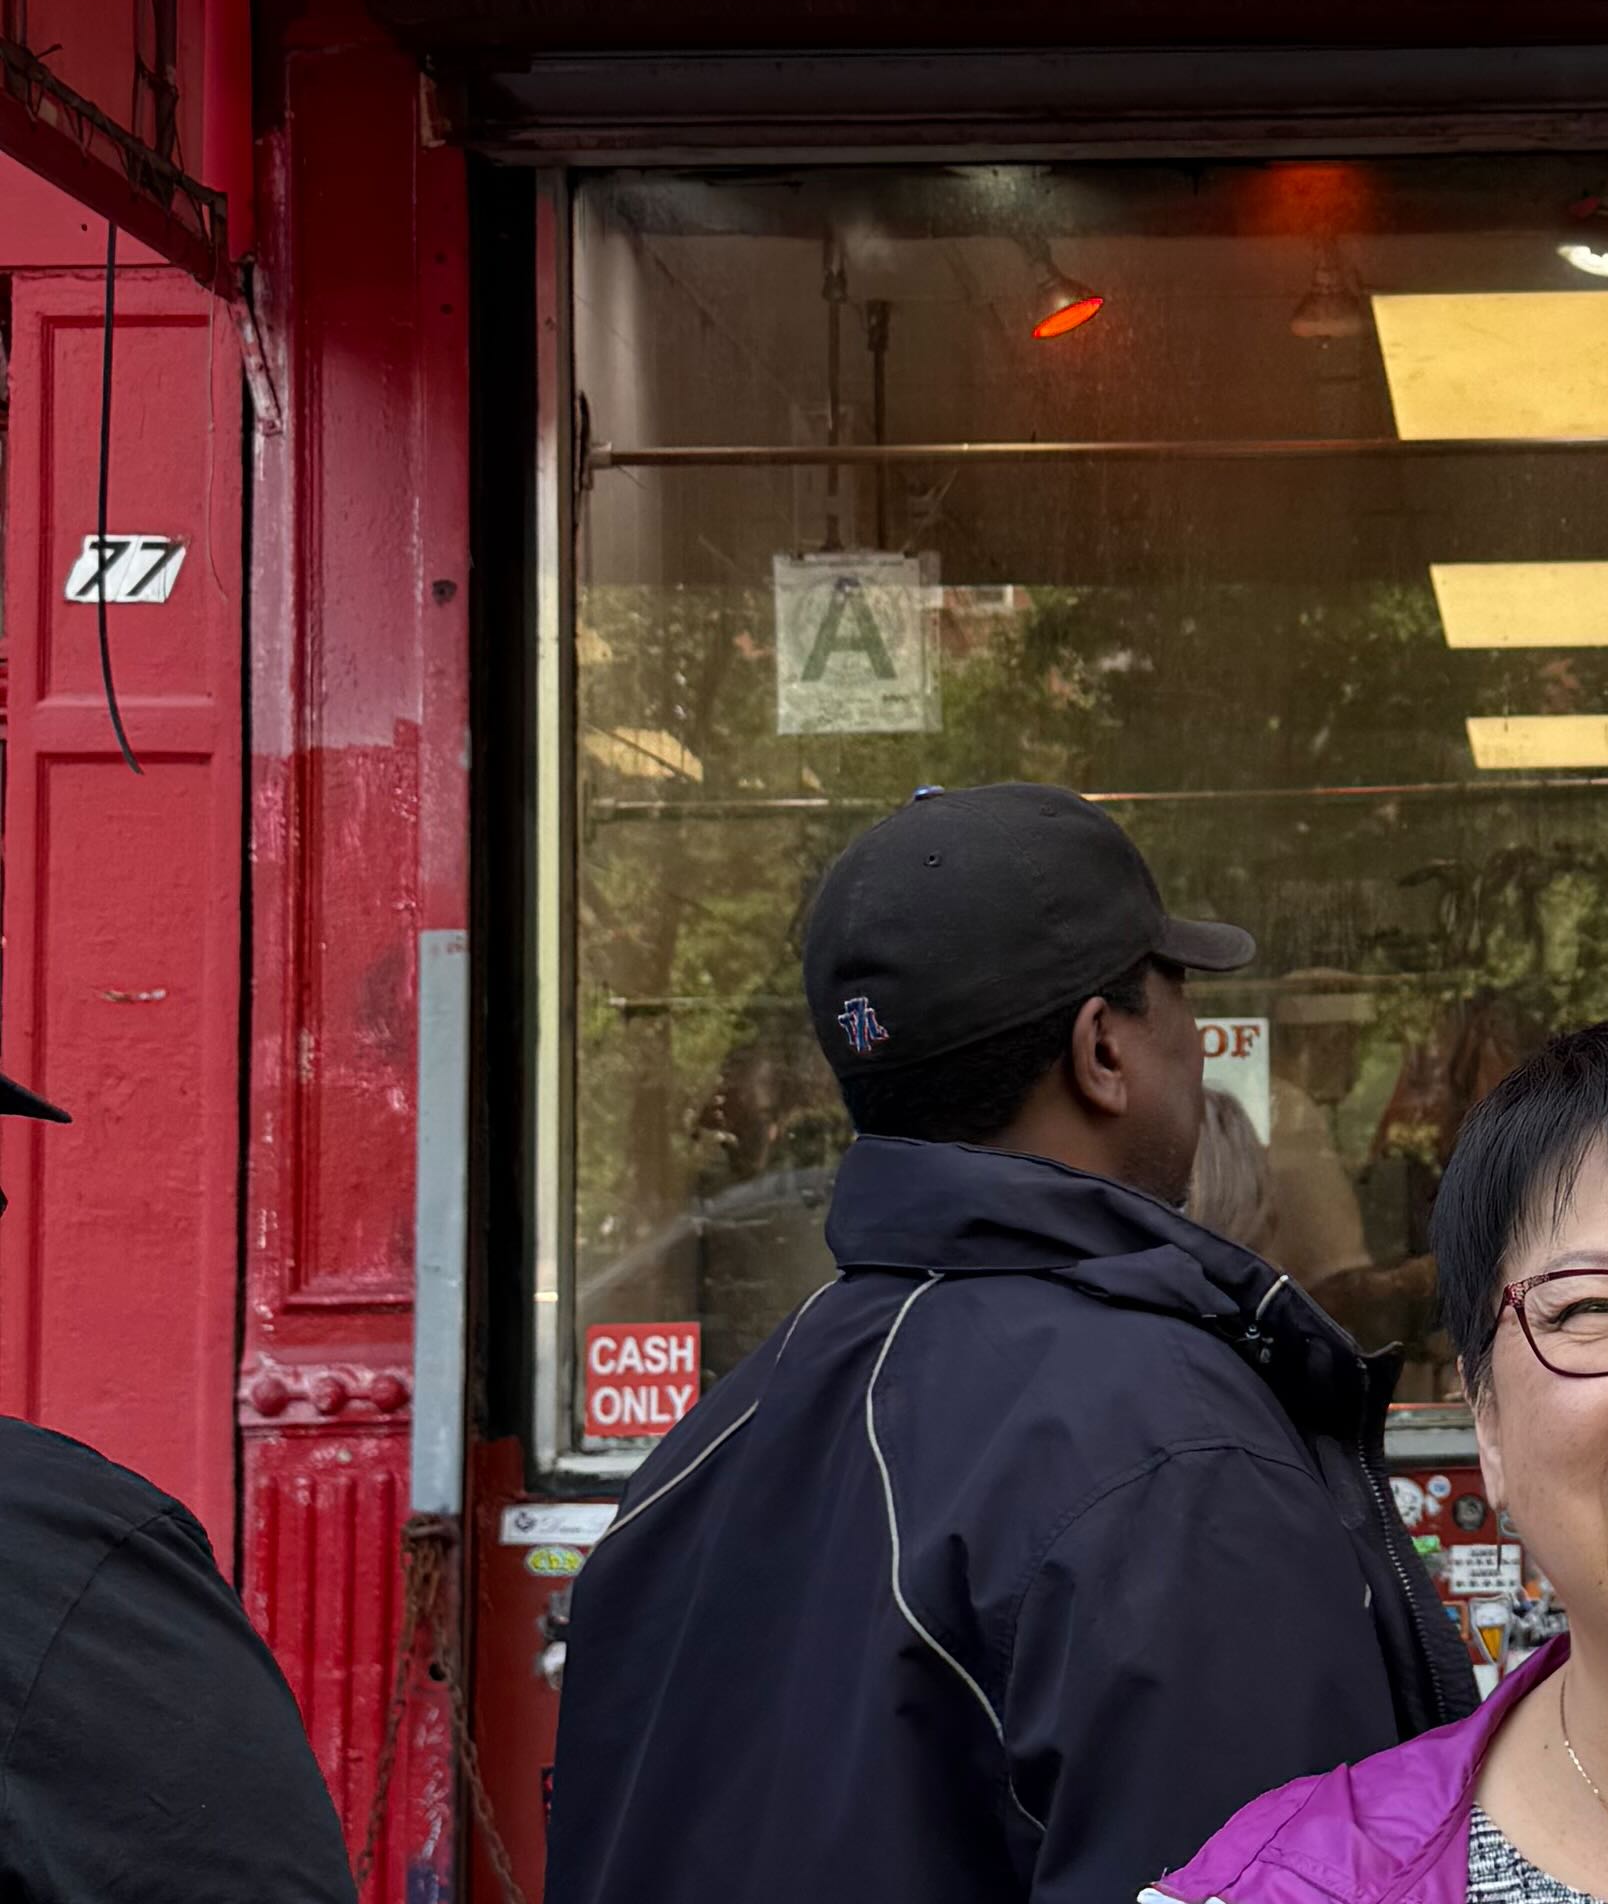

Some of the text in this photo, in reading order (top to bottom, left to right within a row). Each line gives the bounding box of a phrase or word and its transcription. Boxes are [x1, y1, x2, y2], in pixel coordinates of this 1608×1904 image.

[75, 539, 183, 598] 77
[801, 576, 897, 682] A
[590, 1334, 695, 1376] CASH
[592, 1384, 693, 1427] ONLY
